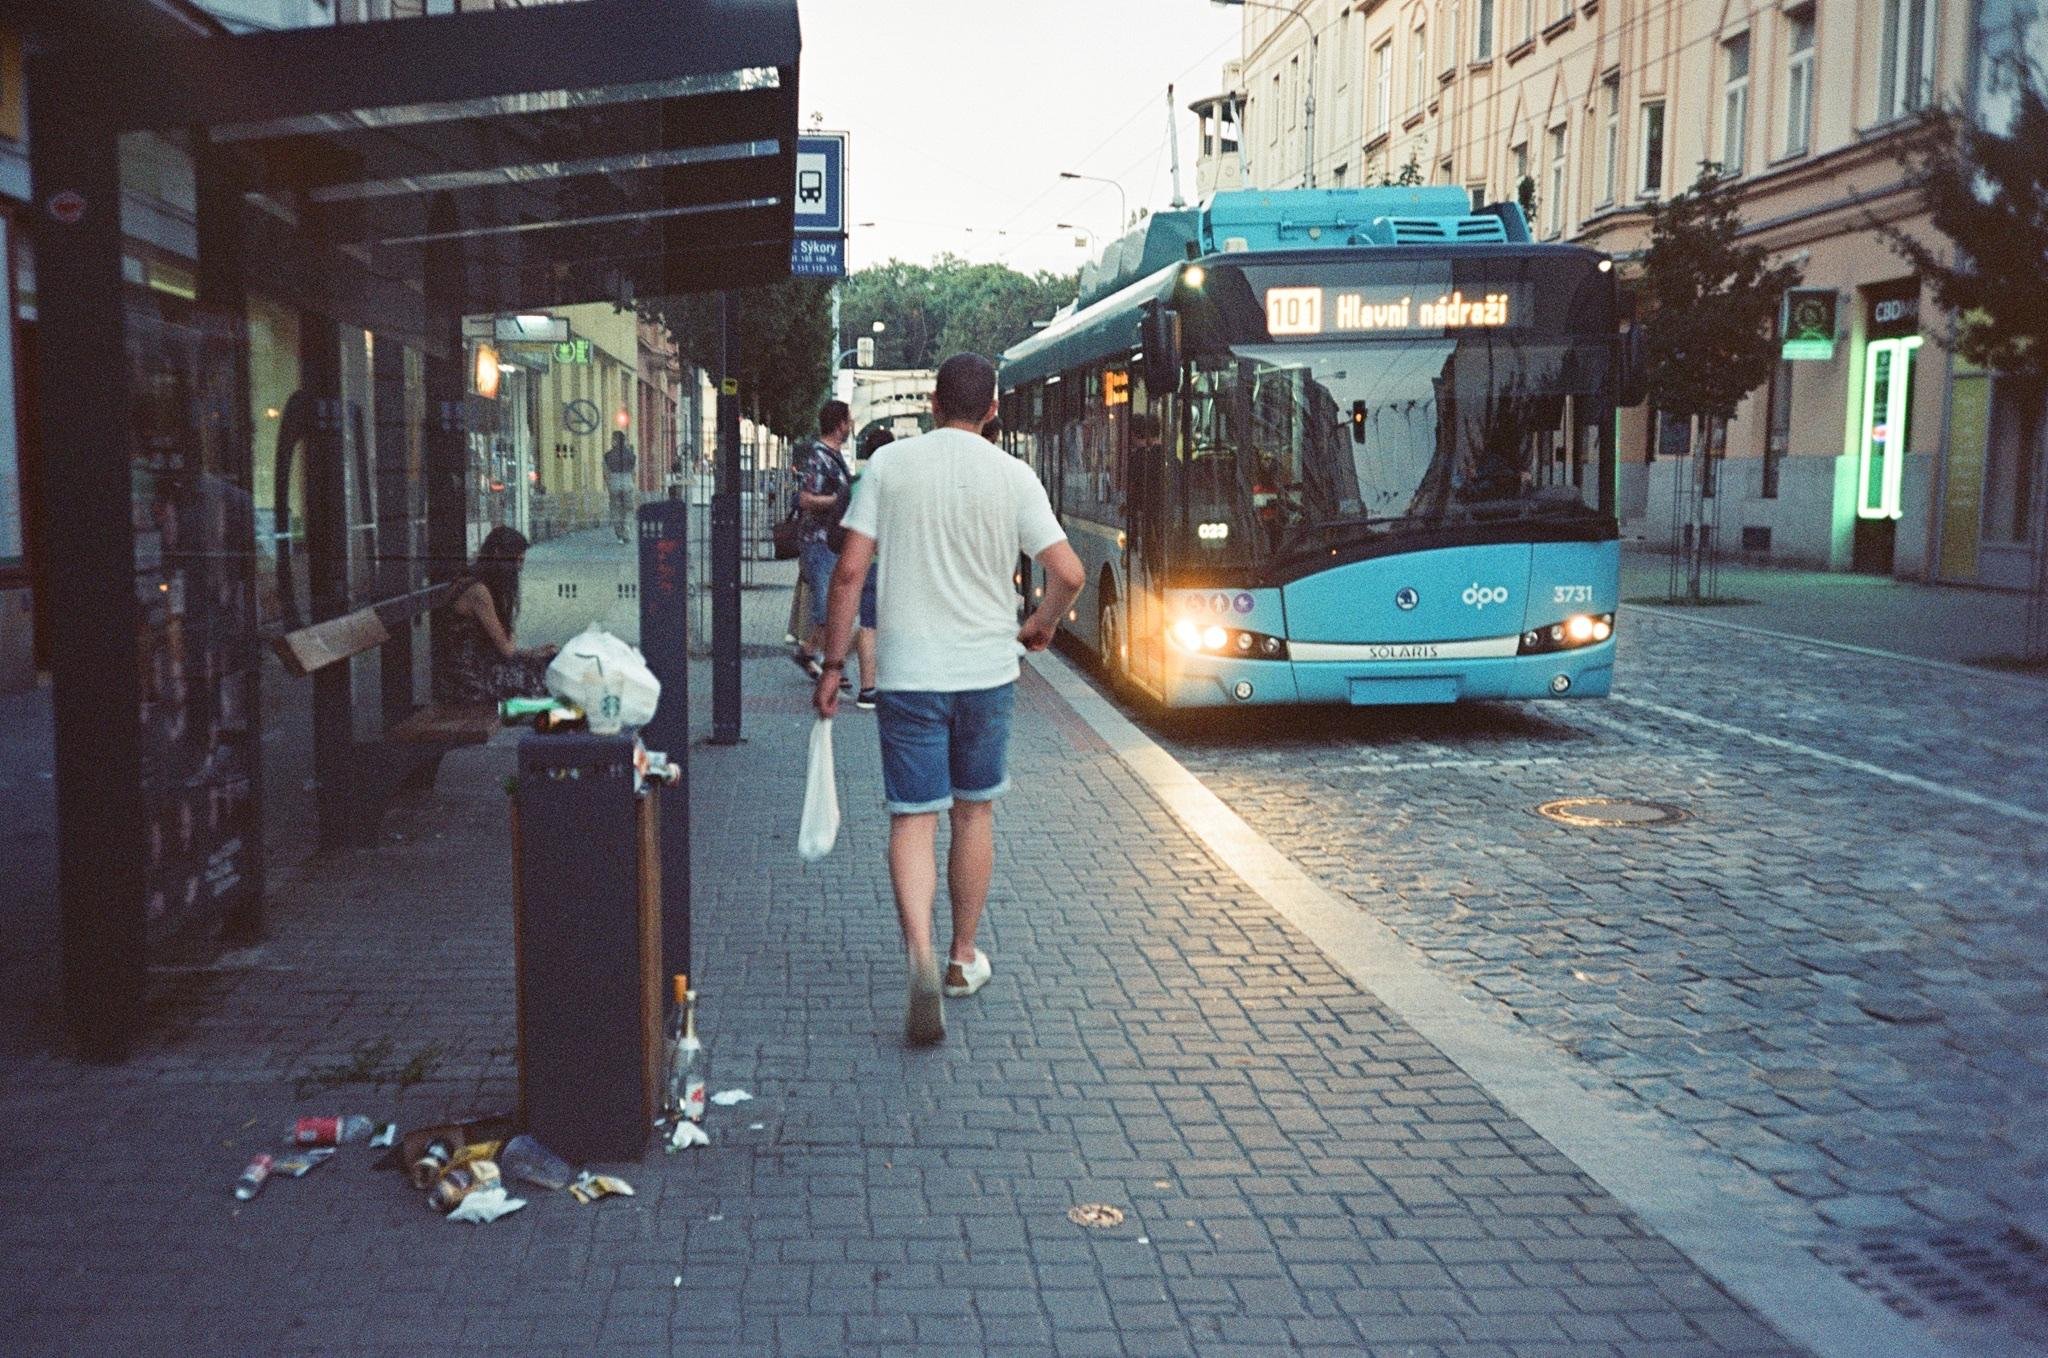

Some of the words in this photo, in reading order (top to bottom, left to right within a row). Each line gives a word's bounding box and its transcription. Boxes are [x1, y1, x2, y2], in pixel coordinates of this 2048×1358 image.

[1272, 296, 1315, 327] 101
[1337, 294, 1410, 329] Hlavní
[1419, 291, 1509, 327] nádraží
[1461, 581, 1509, 611] dpo
[1553, 585, 1594, 604] 3731
[1369, 645, 1439, 659] SOLARIS
